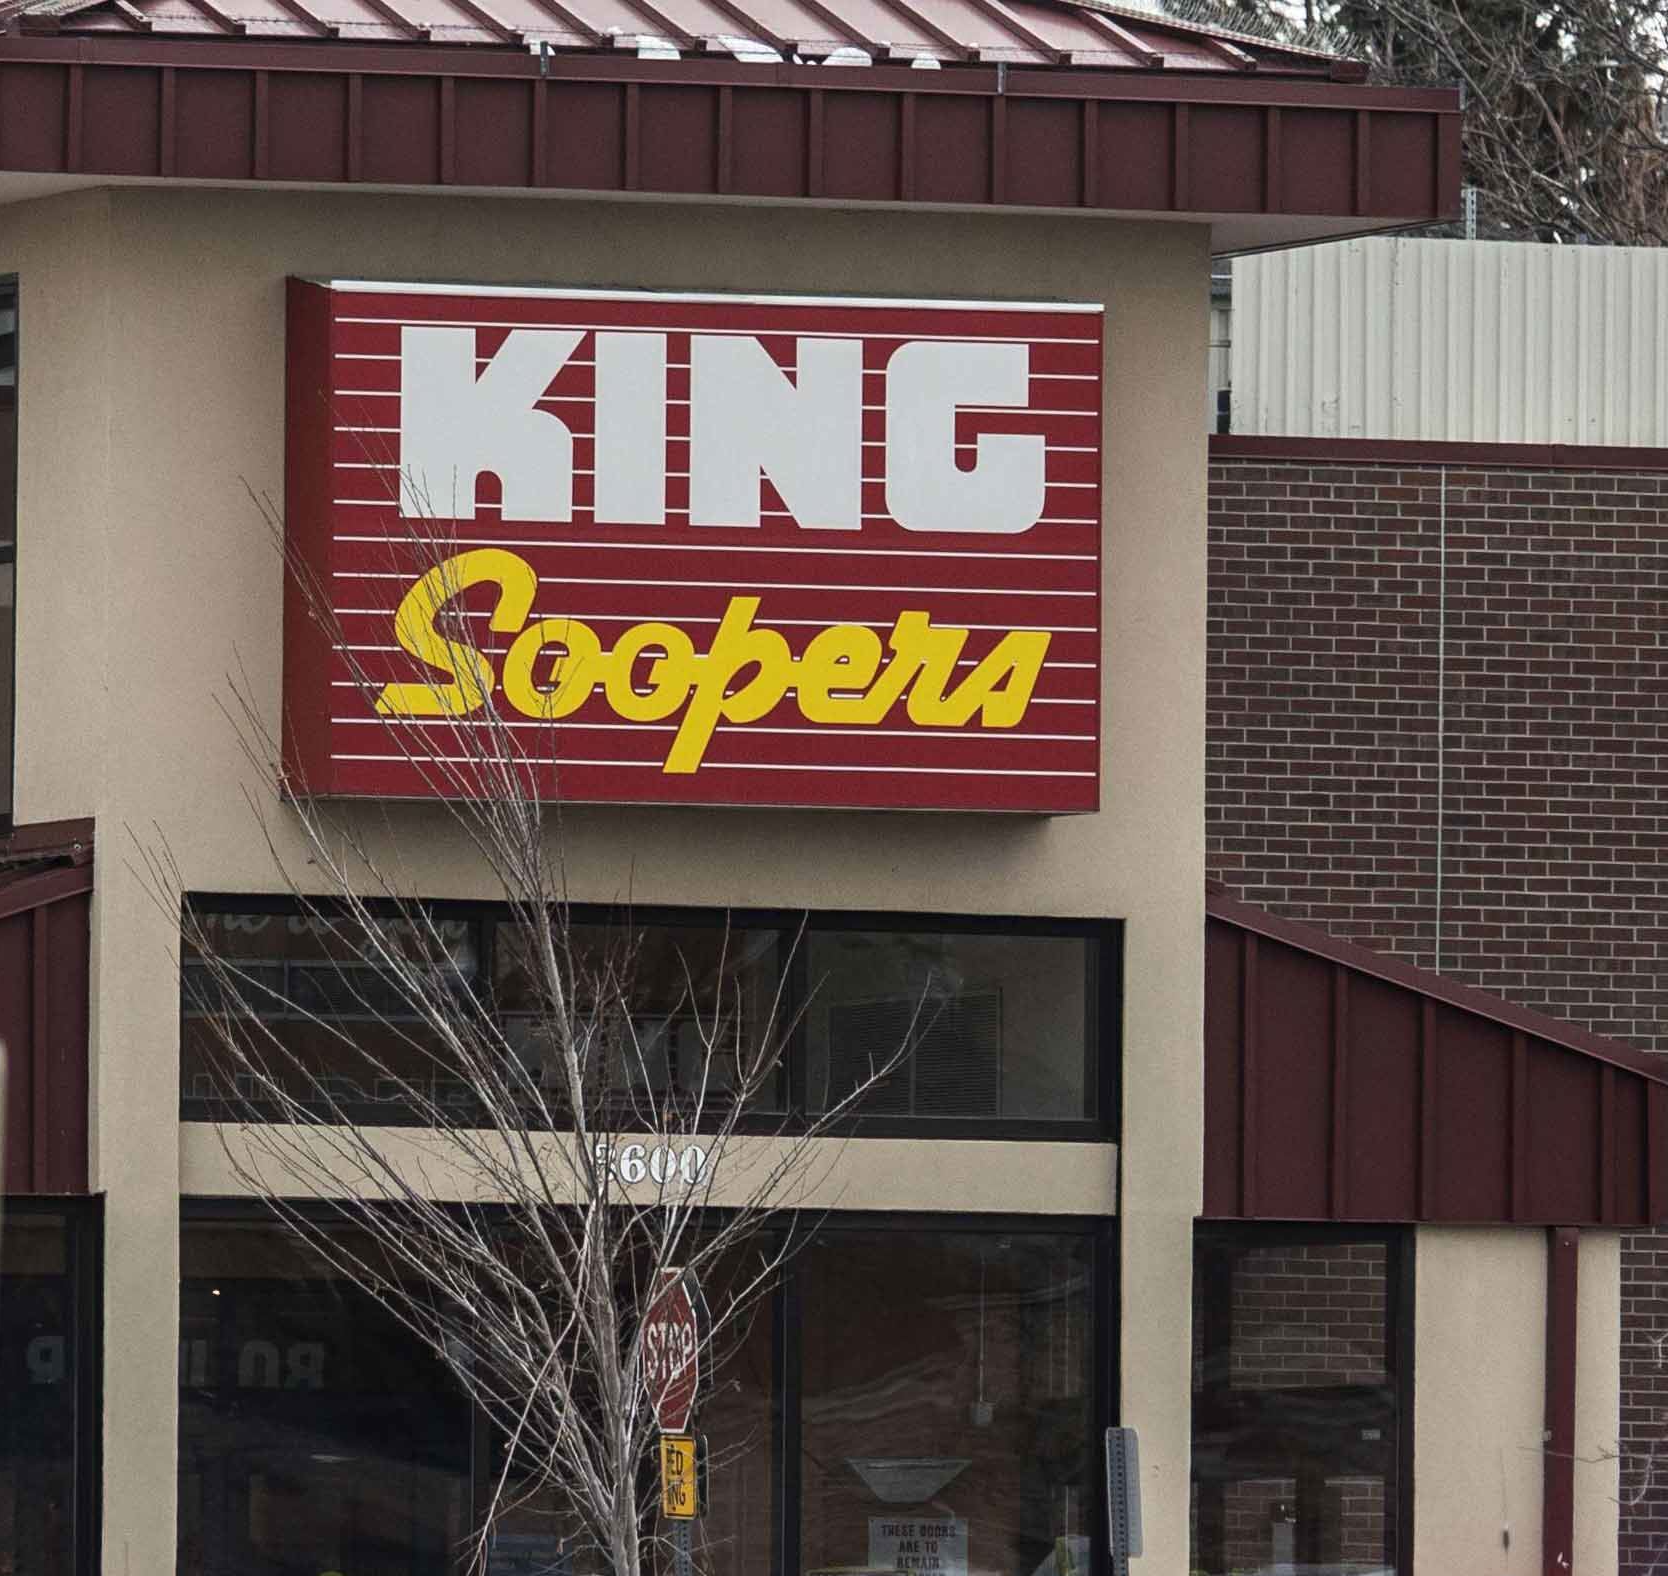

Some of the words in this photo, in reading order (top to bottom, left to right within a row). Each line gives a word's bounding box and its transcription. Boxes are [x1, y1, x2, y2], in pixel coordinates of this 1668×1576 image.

[400, 325, 1046, 534] KING
[374, 548, 1052, 774] Soopers
[647, 1322, 693, 1380] STOP
[882, 1524, 915, 1537] THESE
[919, 1525, 956, 1538] DOORS
[899, 1541, 920, 1552] ARE
[924, 1541, 938, 1553] TO
[897, 1556, 940, 1569] REMAIN
